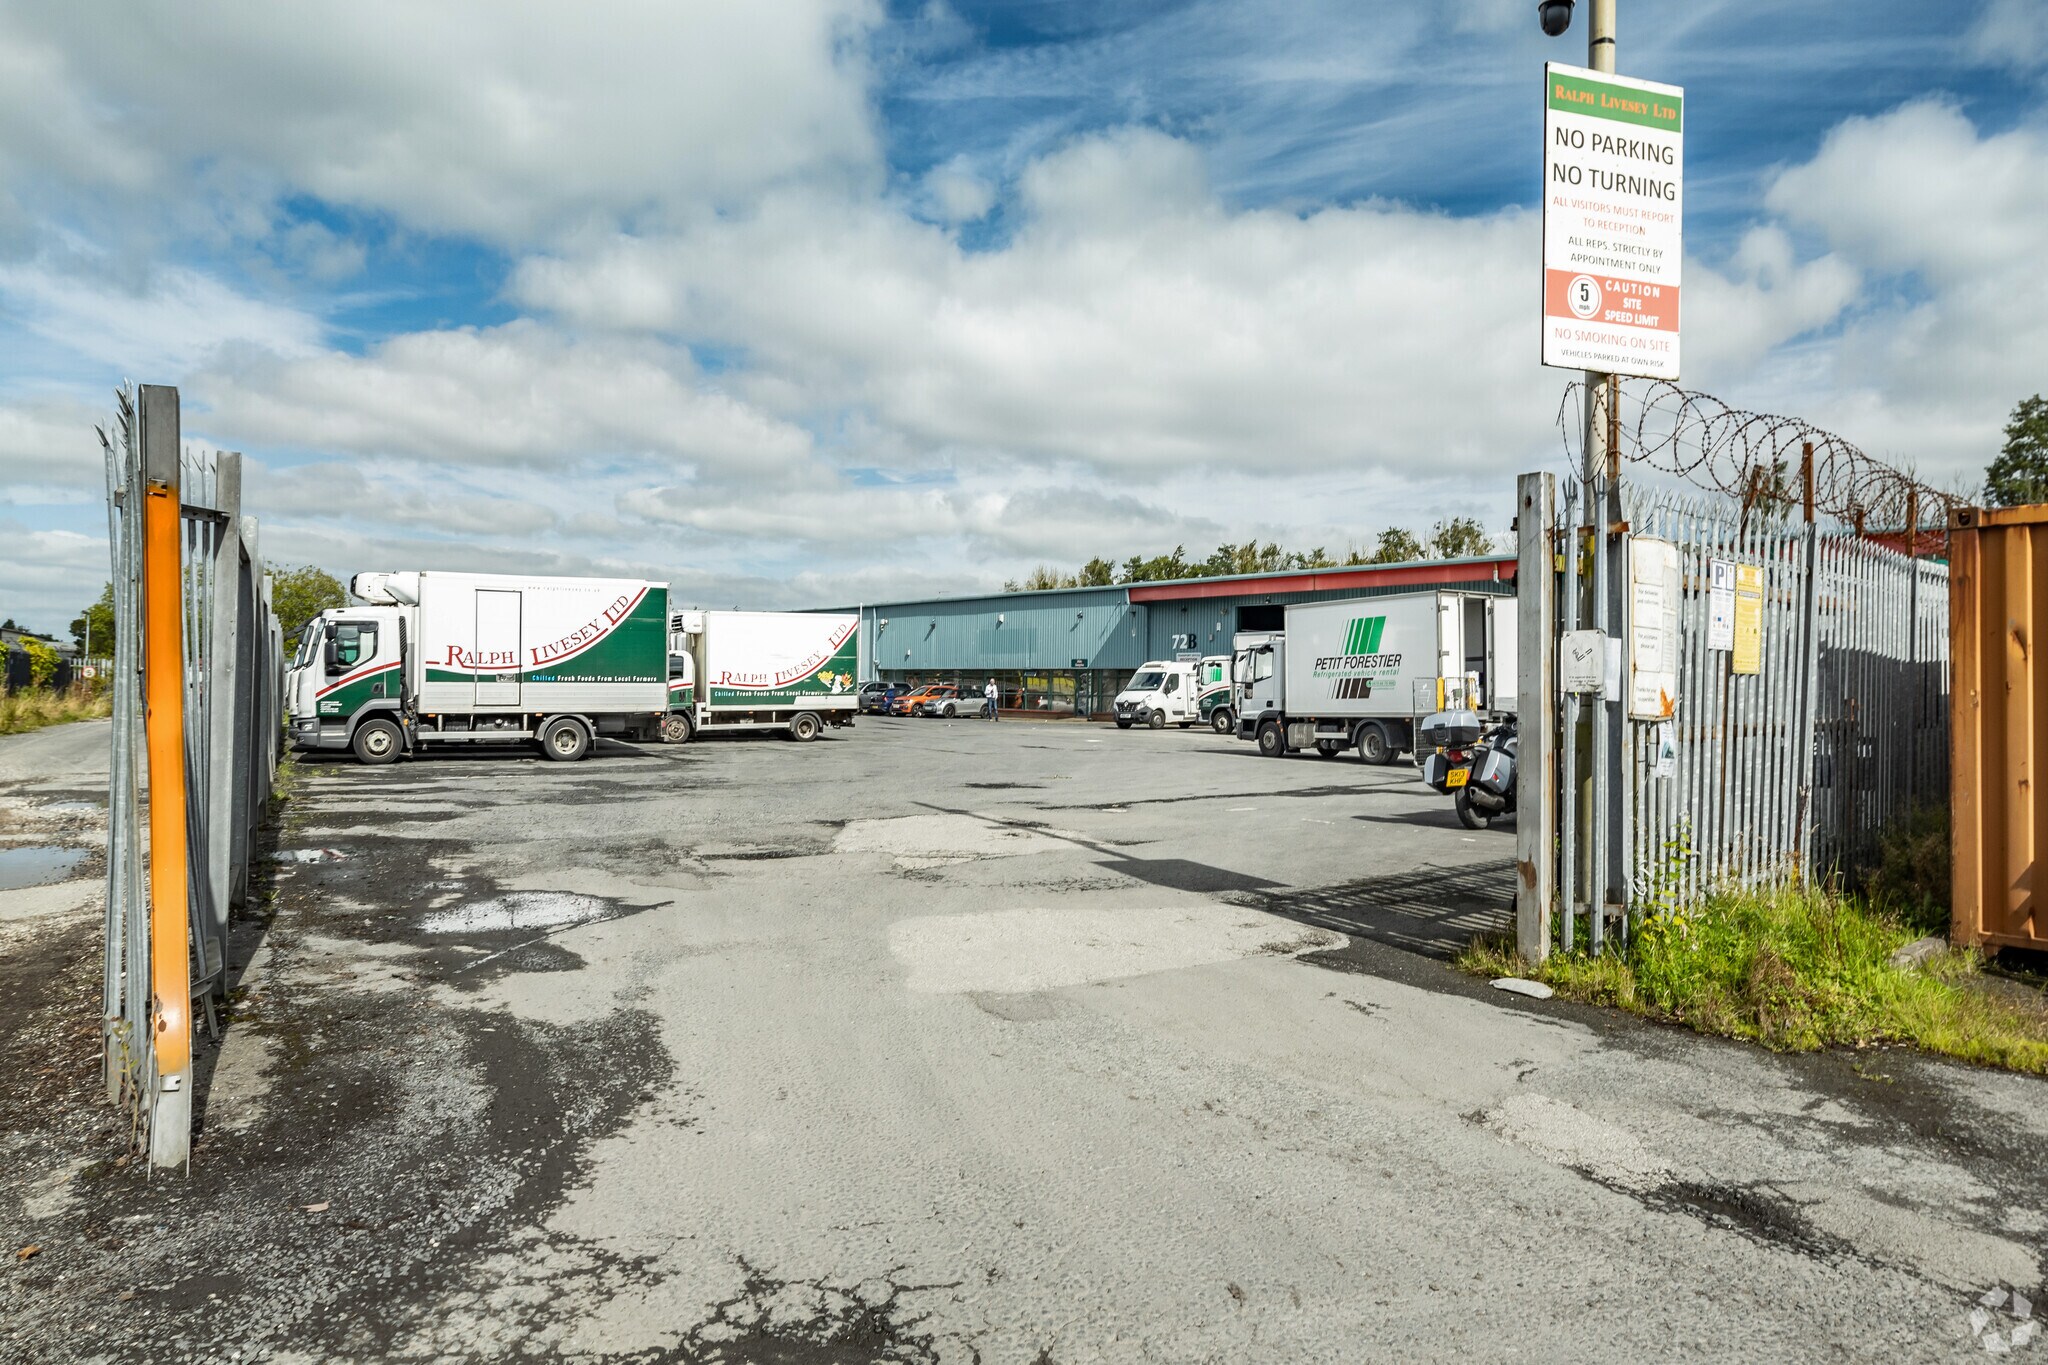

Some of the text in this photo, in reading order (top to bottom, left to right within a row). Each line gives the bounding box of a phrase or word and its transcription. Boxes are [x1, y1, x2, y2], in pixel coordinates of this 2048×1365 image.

[1555, 84, 1676, 120] RALPH LIVESEY LTD
[1556, 126, 1674, 165] NO PARKING
[1553, 162, 1676, 201] NO TURNING
[1553, 196, 1674, 224] ALL VISITORS MUST REPORT
[1583, 217, 1646, 236] TO RECEPTION
[1568, 236, 1584, 247] ALL
[1613, 242, 1651, 257] STRICTLY
[1652, 248, 1663, 259] BY
[1570, 252, 1661, 274] APPOINTMENT ONLY
[1580, 283, 1589, 302] 5
[1605, 280, 1660, 298] CAUTION
[1623, 297, 1642, 311] SITE
[1605, 310, 1660, 327] SPEED LIMIT
[1555, 327, 1671, 352] NO SMOKING ON SITE
[1561, 349, 1593, 360] VEHICLES
[1593, 352, 1620, 363] PARKED
[1631, 357, 1649, 366] OWN
[1650, 359, 1664, 368] RISK
[445, 595, 629, 668] RALPH LIVESEY LTD
[1172, 634, 1197, 650] 72B
[719, 671, 768, 685] RALPH
[775, 650, 822, 685] LIVESEY
[1314, 653, 1402, 670] PETIT FORESTIER
[532, 674, 555, 682] Chilled
[1312, 668, 1400, 679] Refrigerated vehicle rental
